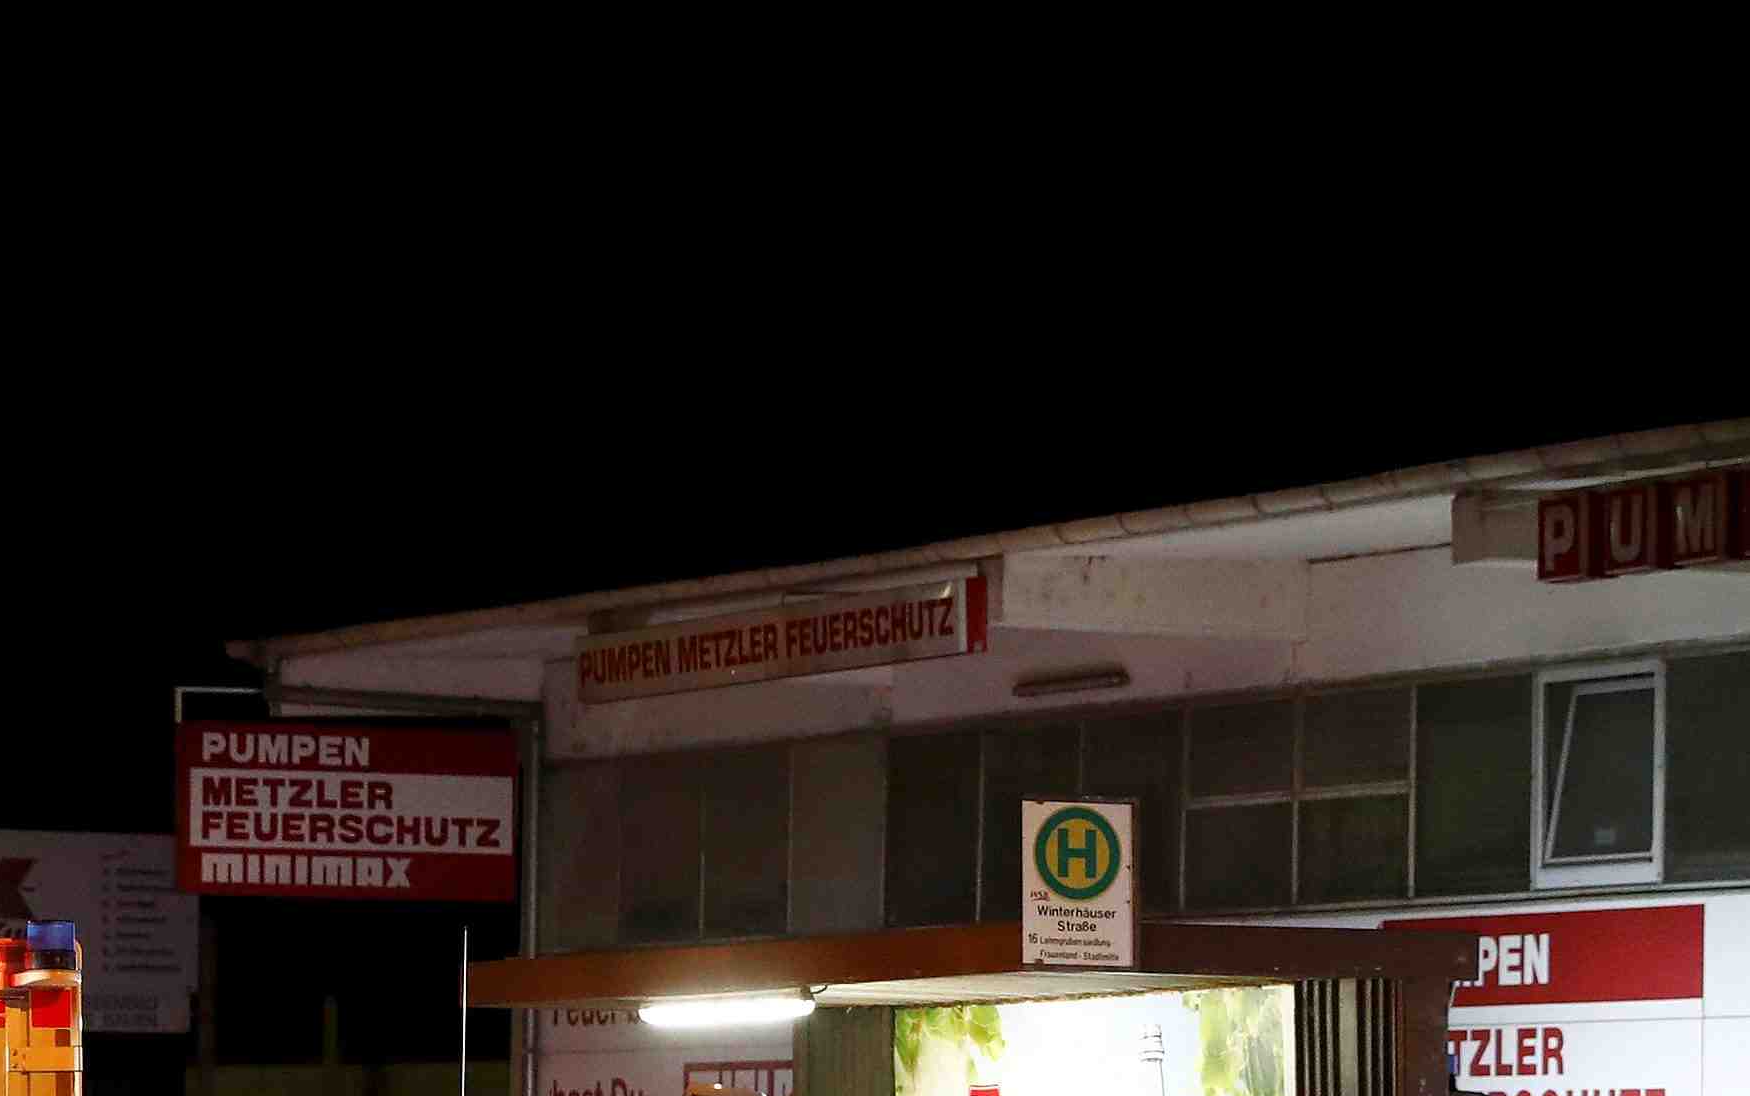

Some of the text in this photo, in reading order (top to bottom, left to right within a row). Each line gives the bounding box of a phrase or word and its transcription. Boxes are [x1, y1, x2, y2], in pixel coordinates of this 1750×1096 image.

[580, 597, 955, 687] PUMPEN METZLER FEUERSCHUTZ
[201, 731, 370, 768] PUMPEN
[202, 777, 393, 809] METZLER
[202, 811, 501, 848] FEUERSCHUTZ
[1057, 828, 1097, 879] H
[1037, 905, 1117, 919] Winterhäuser
[1057, 921, 1097, 932] Straße
[1453, 933, 1550, 988] PEN
